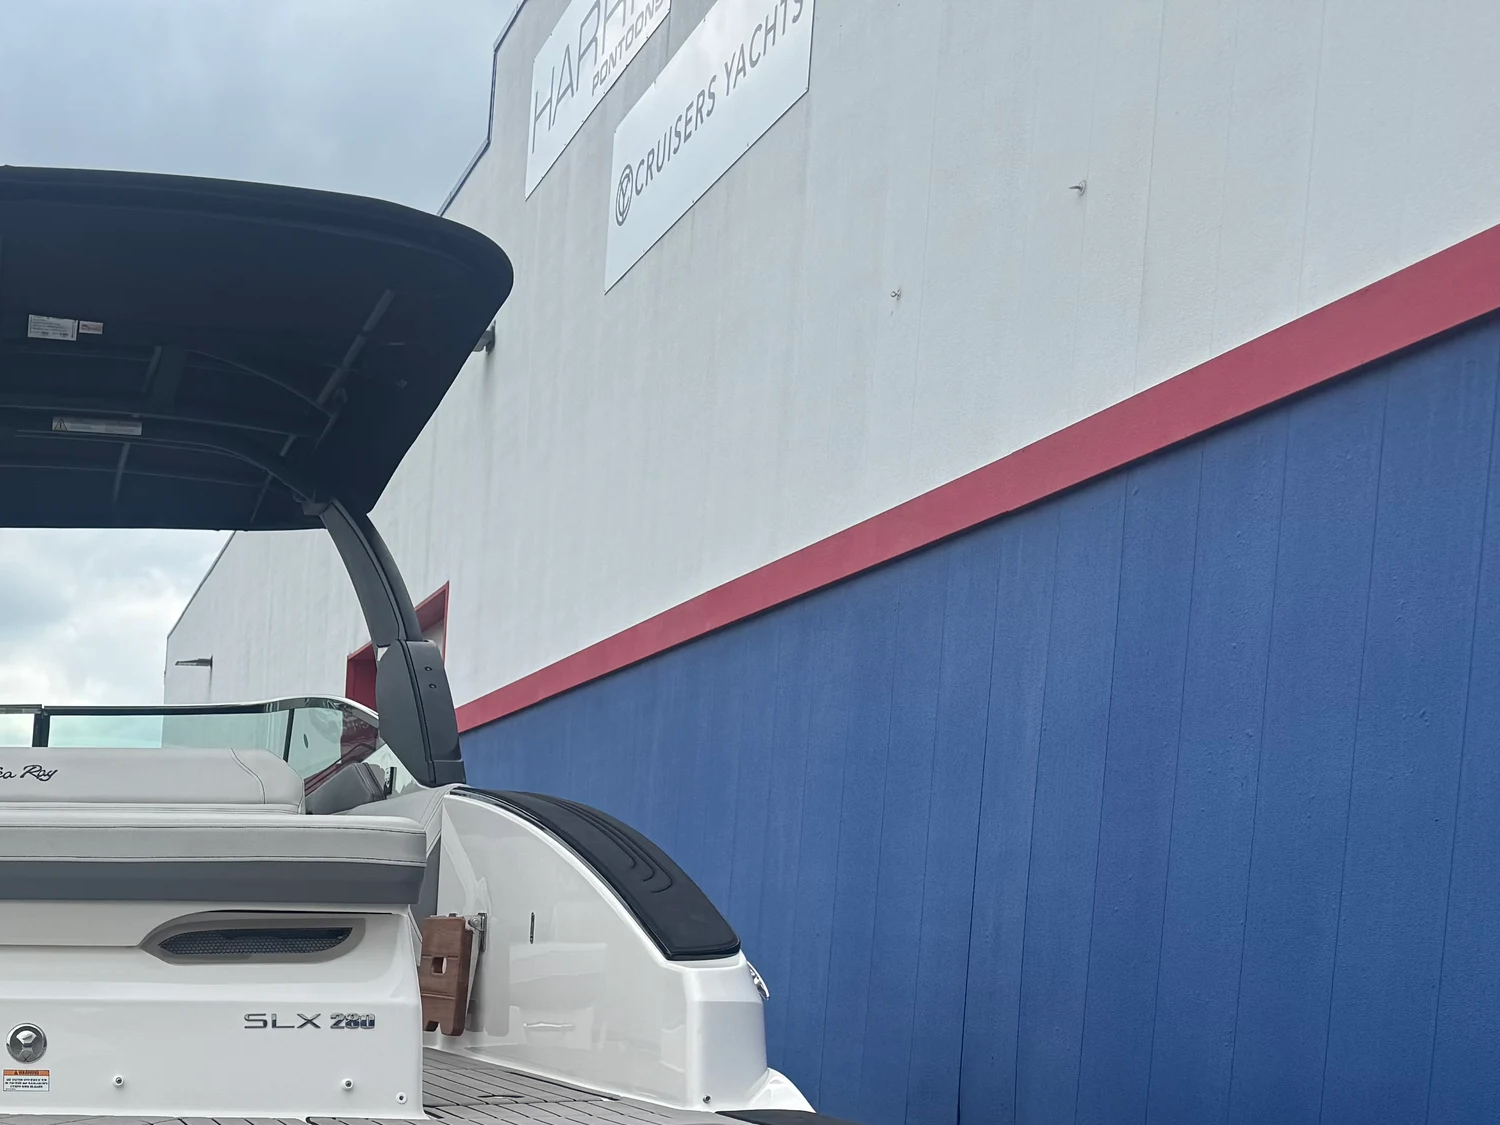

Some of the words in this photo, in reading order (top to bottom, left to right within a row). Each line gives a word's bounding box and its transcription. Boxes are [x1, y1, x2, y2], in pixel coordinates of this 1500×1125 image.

[635, 74, 716, 196] CRUISERS
[20, 764, 59, 782] Ray
[243, 1012, 322, 1030] SLX
[329, 1012, 376, 1030] 280
